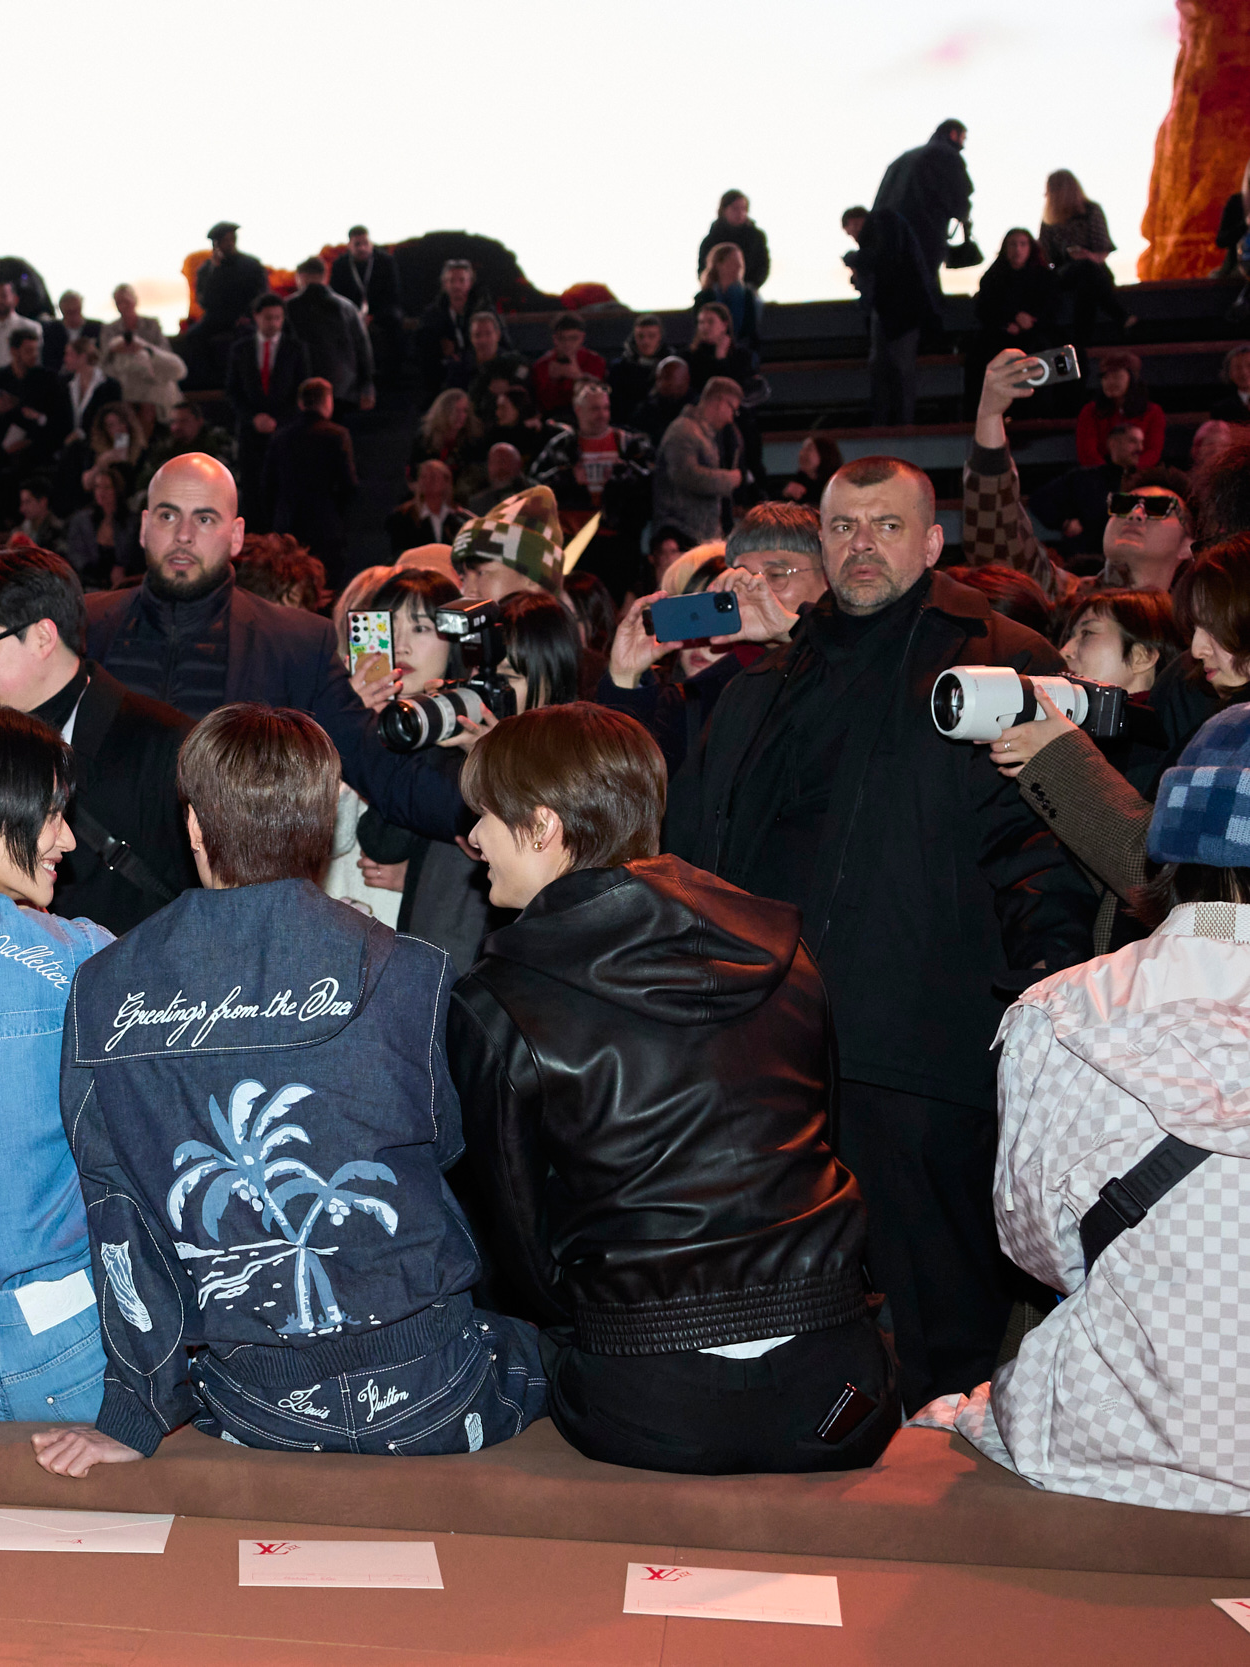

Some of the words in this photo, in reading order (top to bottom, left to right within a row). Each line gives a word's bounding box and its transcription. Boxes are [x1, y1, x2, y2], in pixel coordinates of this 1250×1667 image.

[104, 992, 207, 1052] Greetings
[191, 986, 260, 1047] from
[260, 989, 297, 1018] the
[278, 1384, 331, 1419] Louis
[357, 1378, 410, 1422] Vuitton
